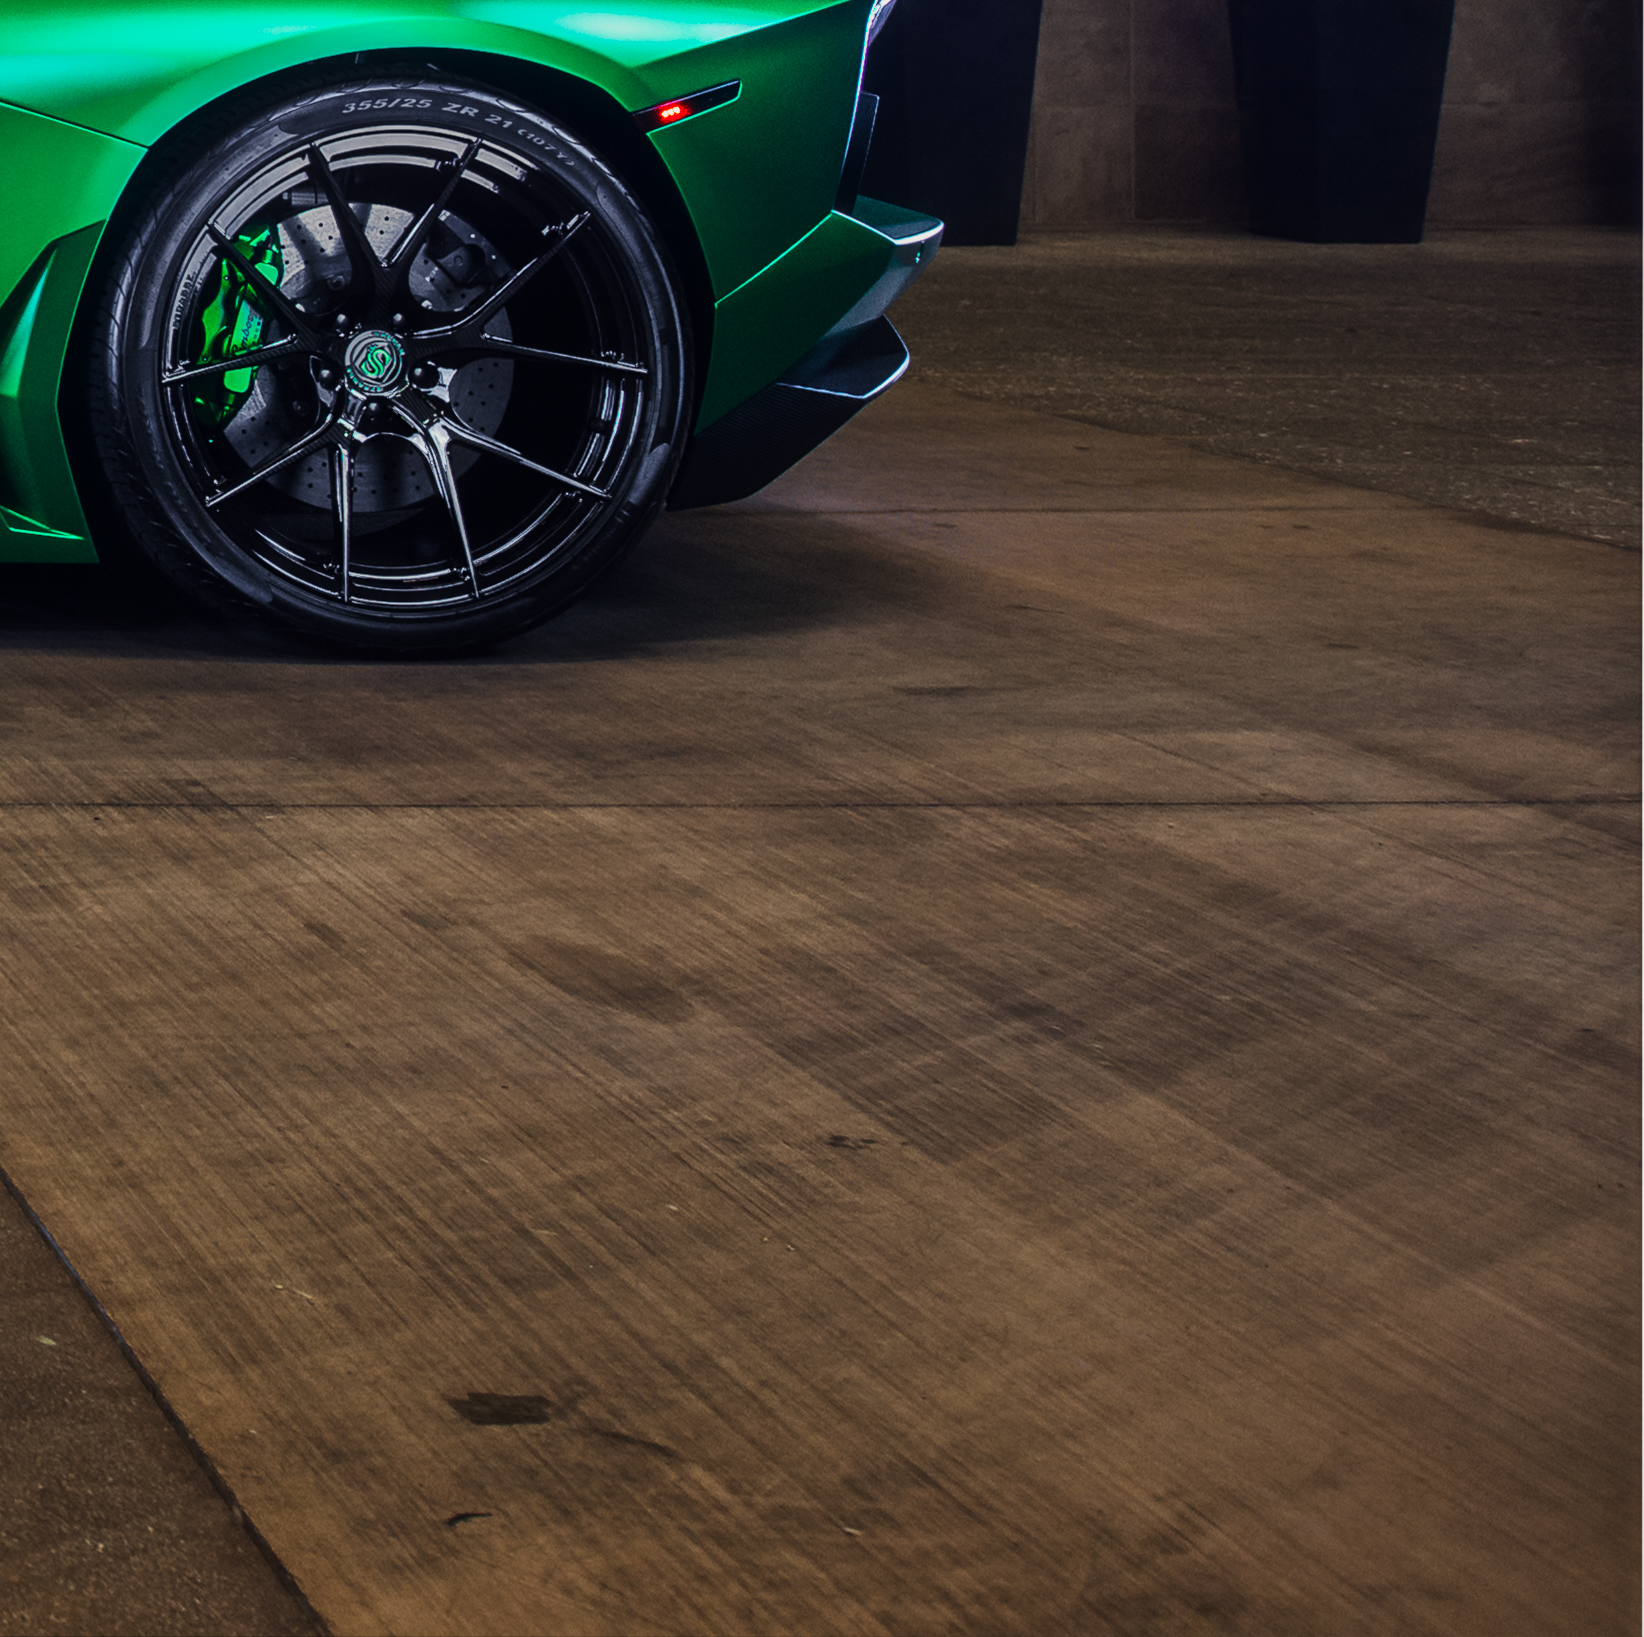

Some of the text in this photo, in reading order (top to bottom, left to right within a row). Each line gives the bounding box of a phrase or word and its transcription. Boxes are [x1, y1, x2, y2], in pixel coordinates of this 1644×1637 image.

[341, 97, 576, 167] 355/25 ZR 21 (107Y)
